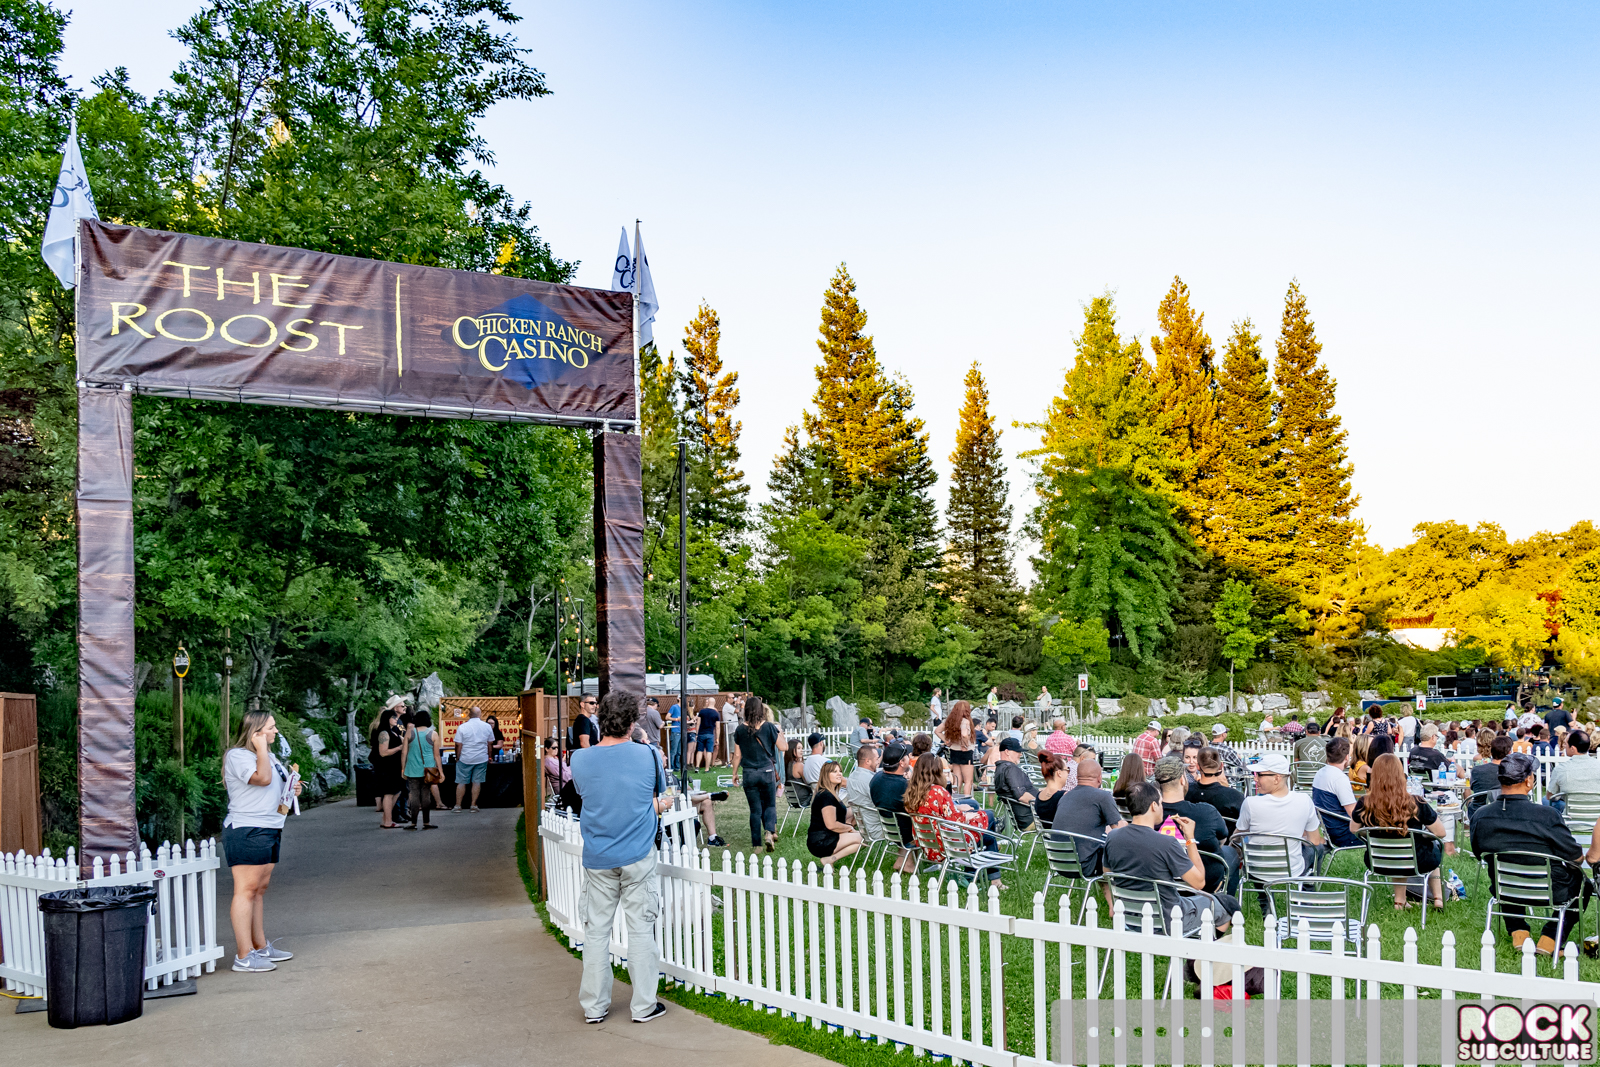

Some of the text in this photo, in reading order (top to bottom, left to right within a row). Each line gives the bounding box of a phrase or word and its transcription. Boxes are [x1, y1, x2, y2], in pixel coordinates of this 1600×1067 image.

[162, 260, 312, 309] THE
[110, 302, 364, 356] ROOST
[452, 313, 603, 354] CHICKEN RANCH
[478, 335, 589, 372] CASINO
[1080, 679, 1086, 688] D
[1418, 700, 1424, 708] A
